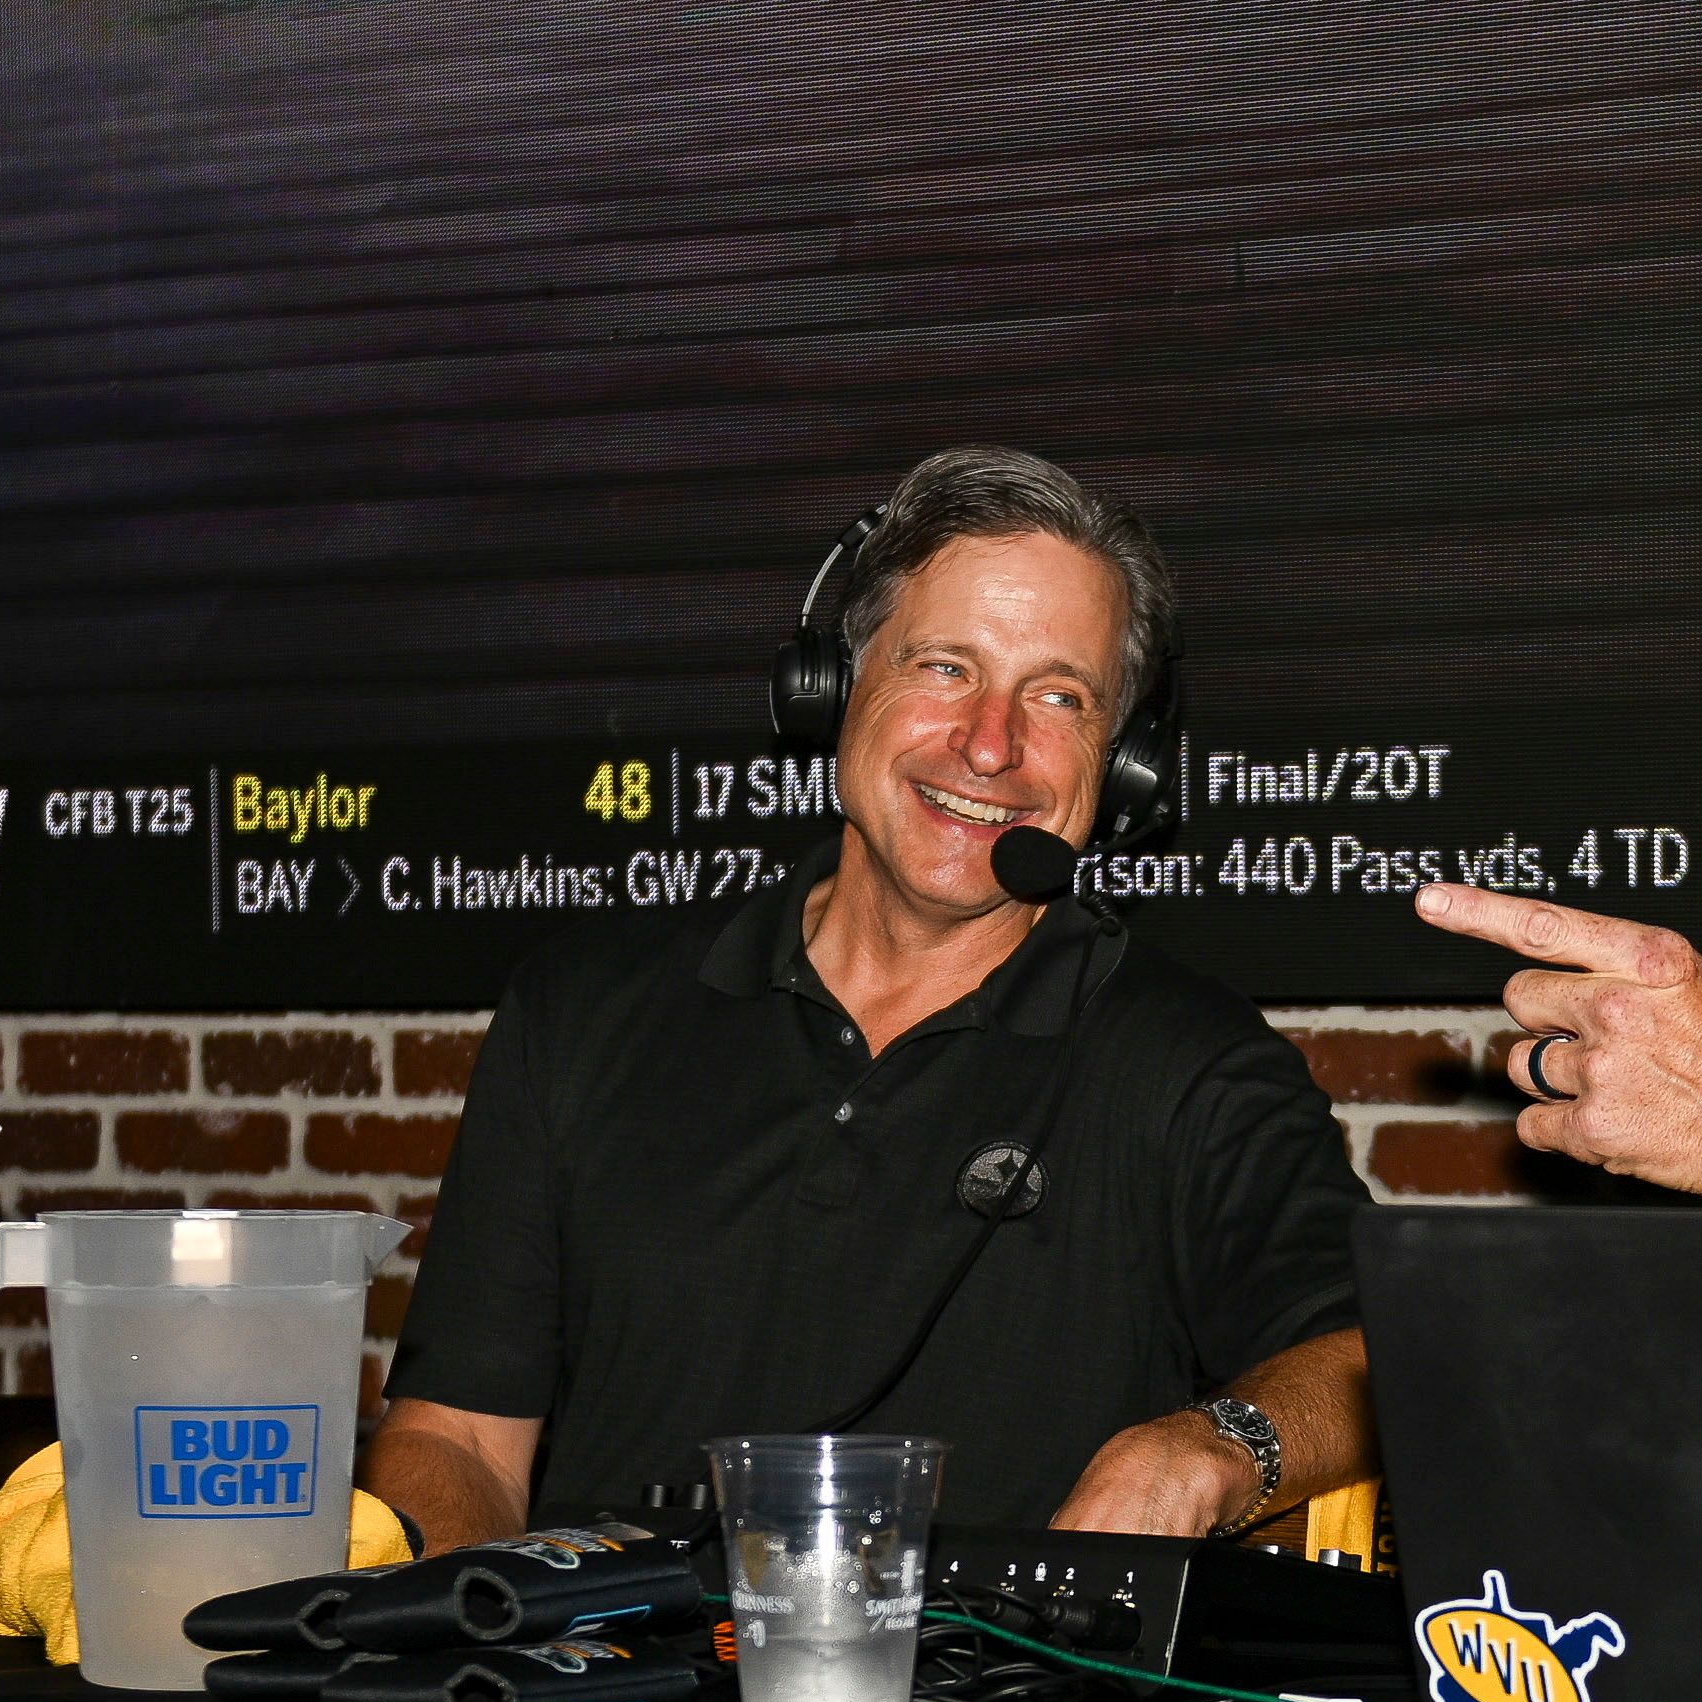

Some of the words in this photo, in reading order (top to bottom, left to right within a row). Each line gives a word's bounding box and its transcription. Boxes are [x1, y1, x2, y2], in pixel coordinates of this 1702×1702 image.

[44, 788, 117, 838] CFB
[125, 787, 196, 835] T25
[233, 770, 378, 844] Baylor
[584, 759, 651, 821] 48
[693, 761, 735, 819] 17
[236, 857, 317, 914] BAY
[381, 854, 423, 911] C.
[431, 853, 616, 910] Hawkins:
[627, 849, 702, 906] GW
[1218, 836, 1317, 896] 440
[1331, 834, 1443, 895] Pass
[1567, 829, 1602, 889] 4
[1614, 827, 1689, 888] TD
[172, 1419, 290, 1461] BUD
[149, 1463, 307, 1506] LIGHT
[949, 1560, 959, 1573] 4
[1007, 1563, 1017, 1576] 3
[1065, 1567, 1076, 1580] 2
[1126, 1571, 1134, 1584] 1
